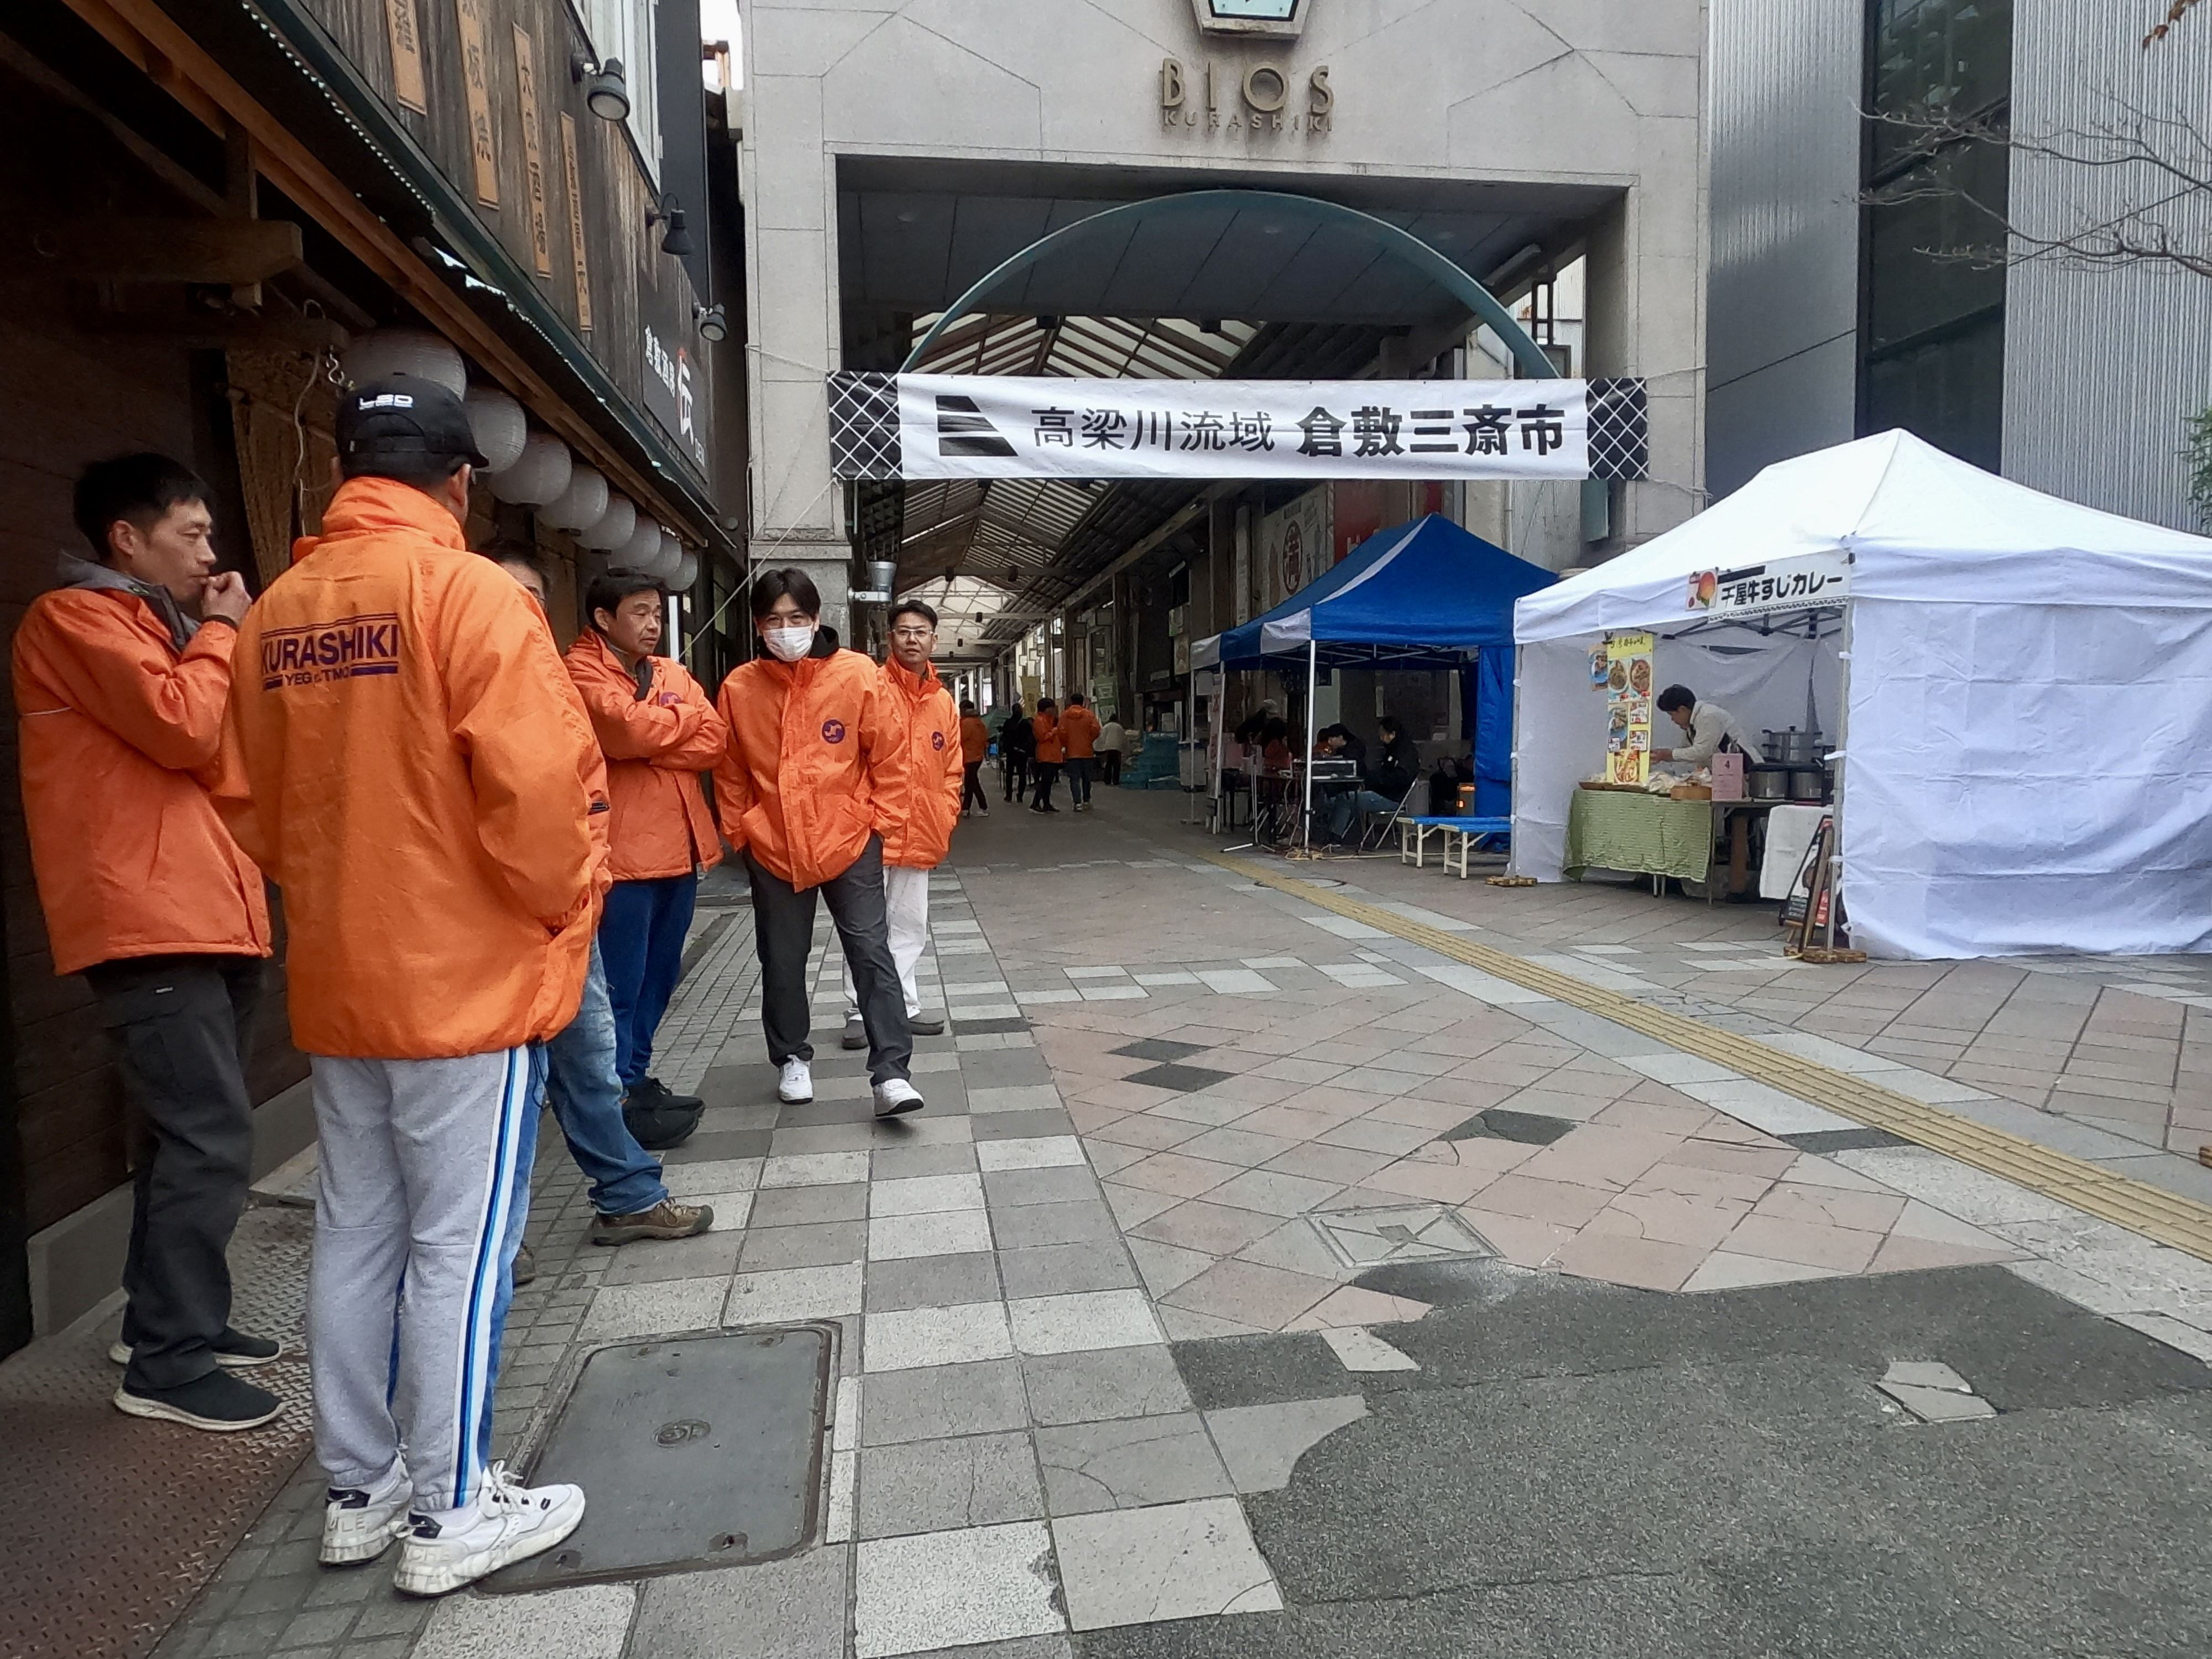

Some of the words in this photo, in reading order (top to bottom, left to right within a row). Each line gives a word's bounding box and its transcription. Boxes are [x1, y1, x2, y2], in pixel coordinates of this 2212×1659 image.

[1161, 58, 1334, 115] BIOS
[1164, 113, 1333, 131] KURASHIKI
[1031, 406, 1275, 451] 高梁川流域
[1295, 403, 1565, 457] 倉敷三斎市
